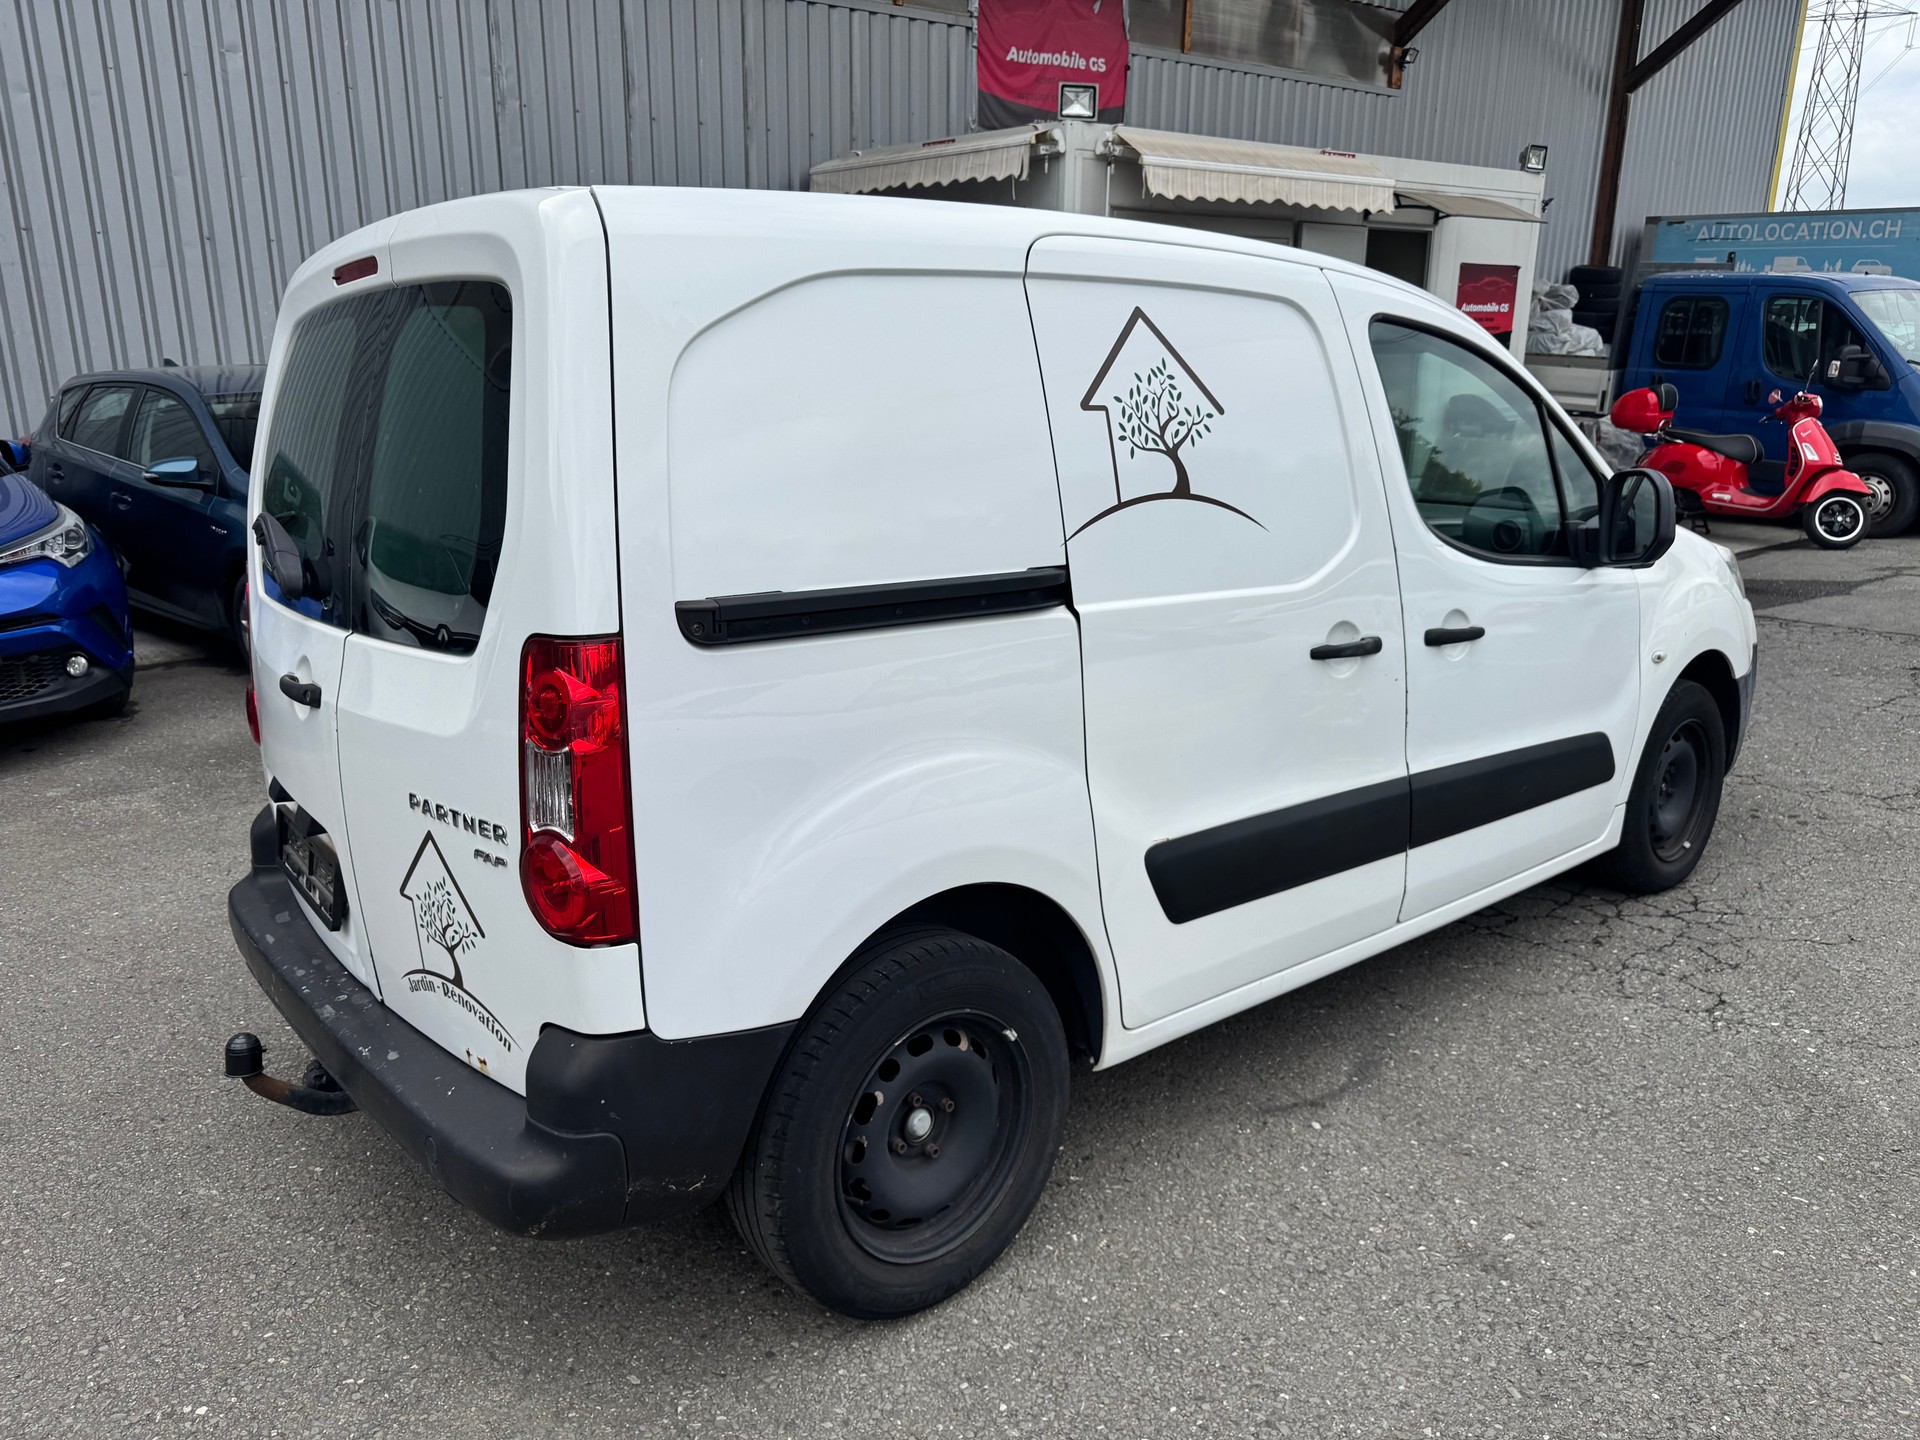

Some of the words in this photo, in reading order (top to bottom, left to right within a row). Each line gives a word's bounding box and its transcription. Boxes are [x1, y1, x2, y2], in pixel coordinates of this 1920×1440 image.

[1006, 46, 1086, 70] Automobile
[1695, 219, 1902, 243] AUTOLOCATION.CH
[1461, 302, 1499, 312] Automobile
[408, 792, 509, 846] PARTNER
[473, 848, 508, 868] FAP
[408, 975, 436, 993] Jardin
[441, 981, 512, 1053] Rénovation
